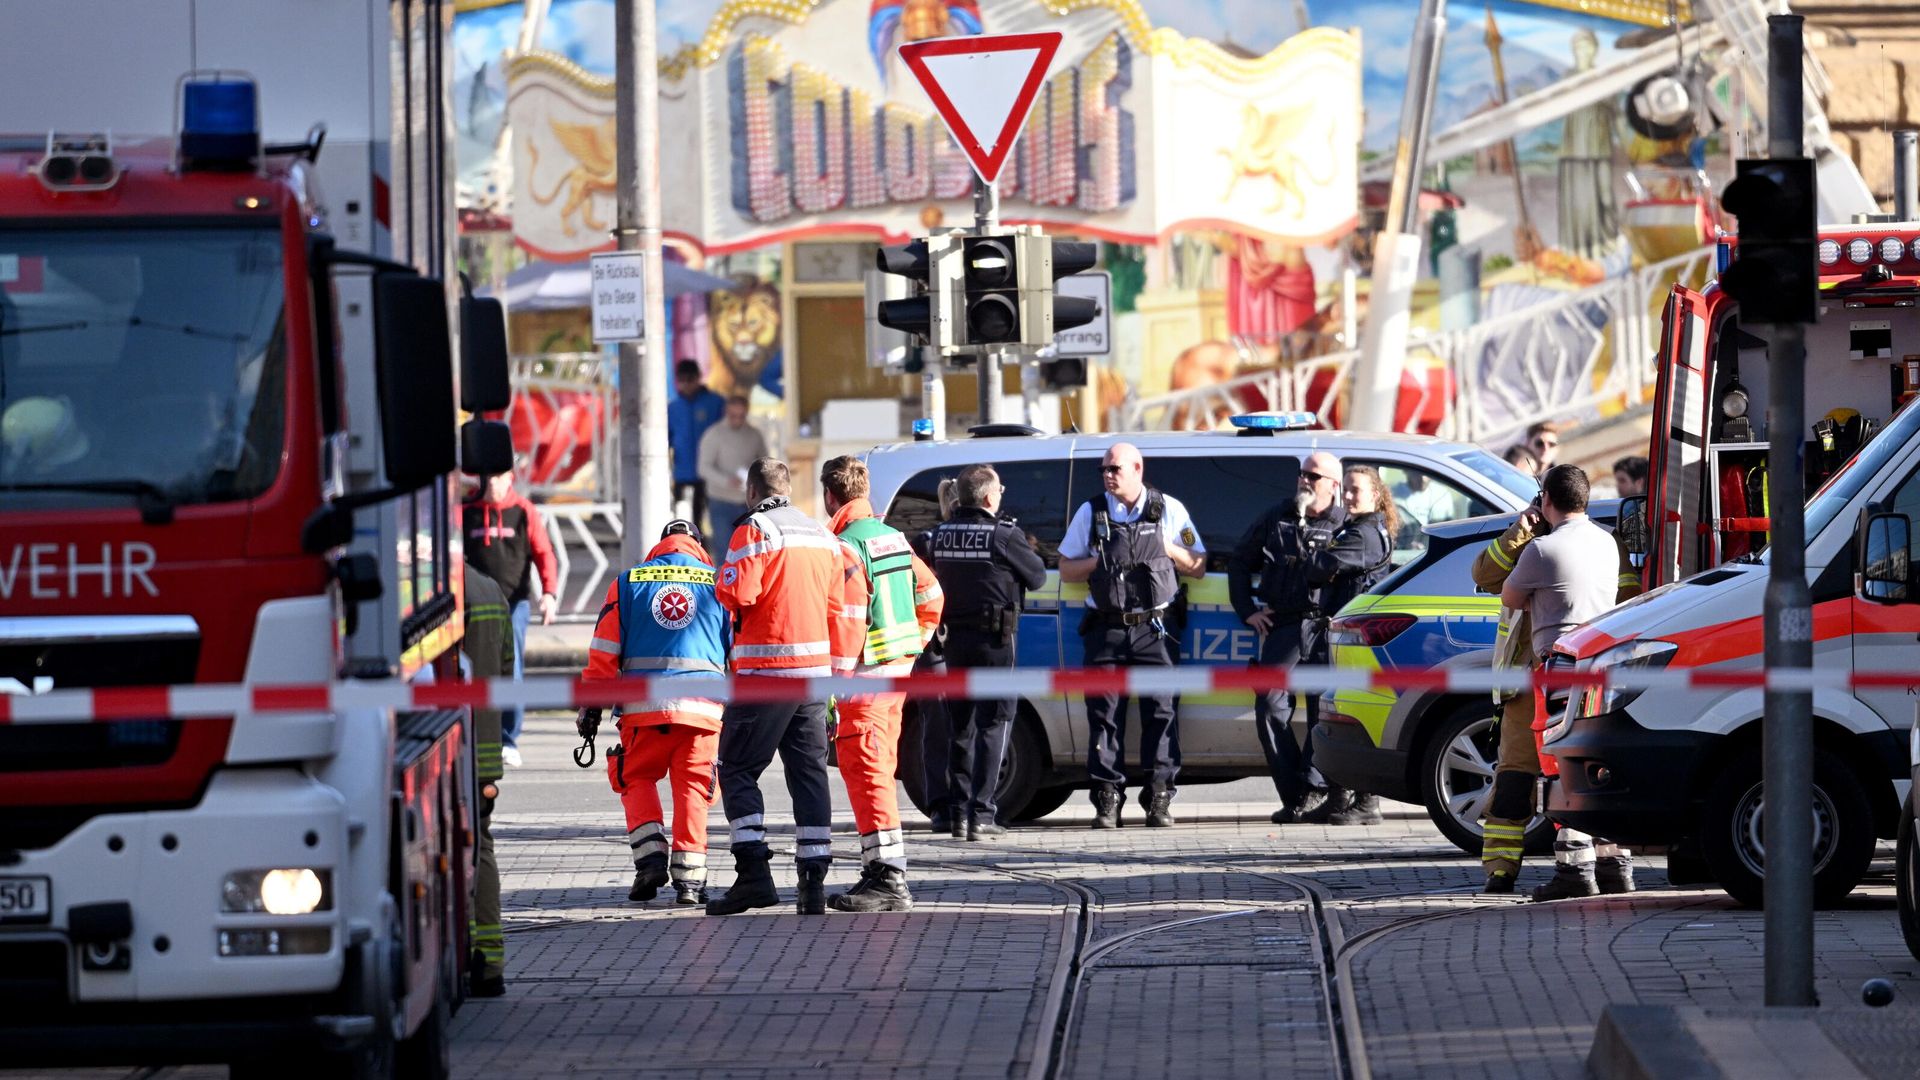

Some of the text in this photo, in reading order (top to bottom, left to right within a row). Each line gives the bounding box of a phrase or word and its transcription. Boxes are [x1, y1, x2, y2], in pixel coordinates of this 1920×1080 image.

[729, 33, 1136, 222] COLOSUS
[1053, 332, 1102, 346] orrang
[935, 531, 990, 549] POLIZEI
